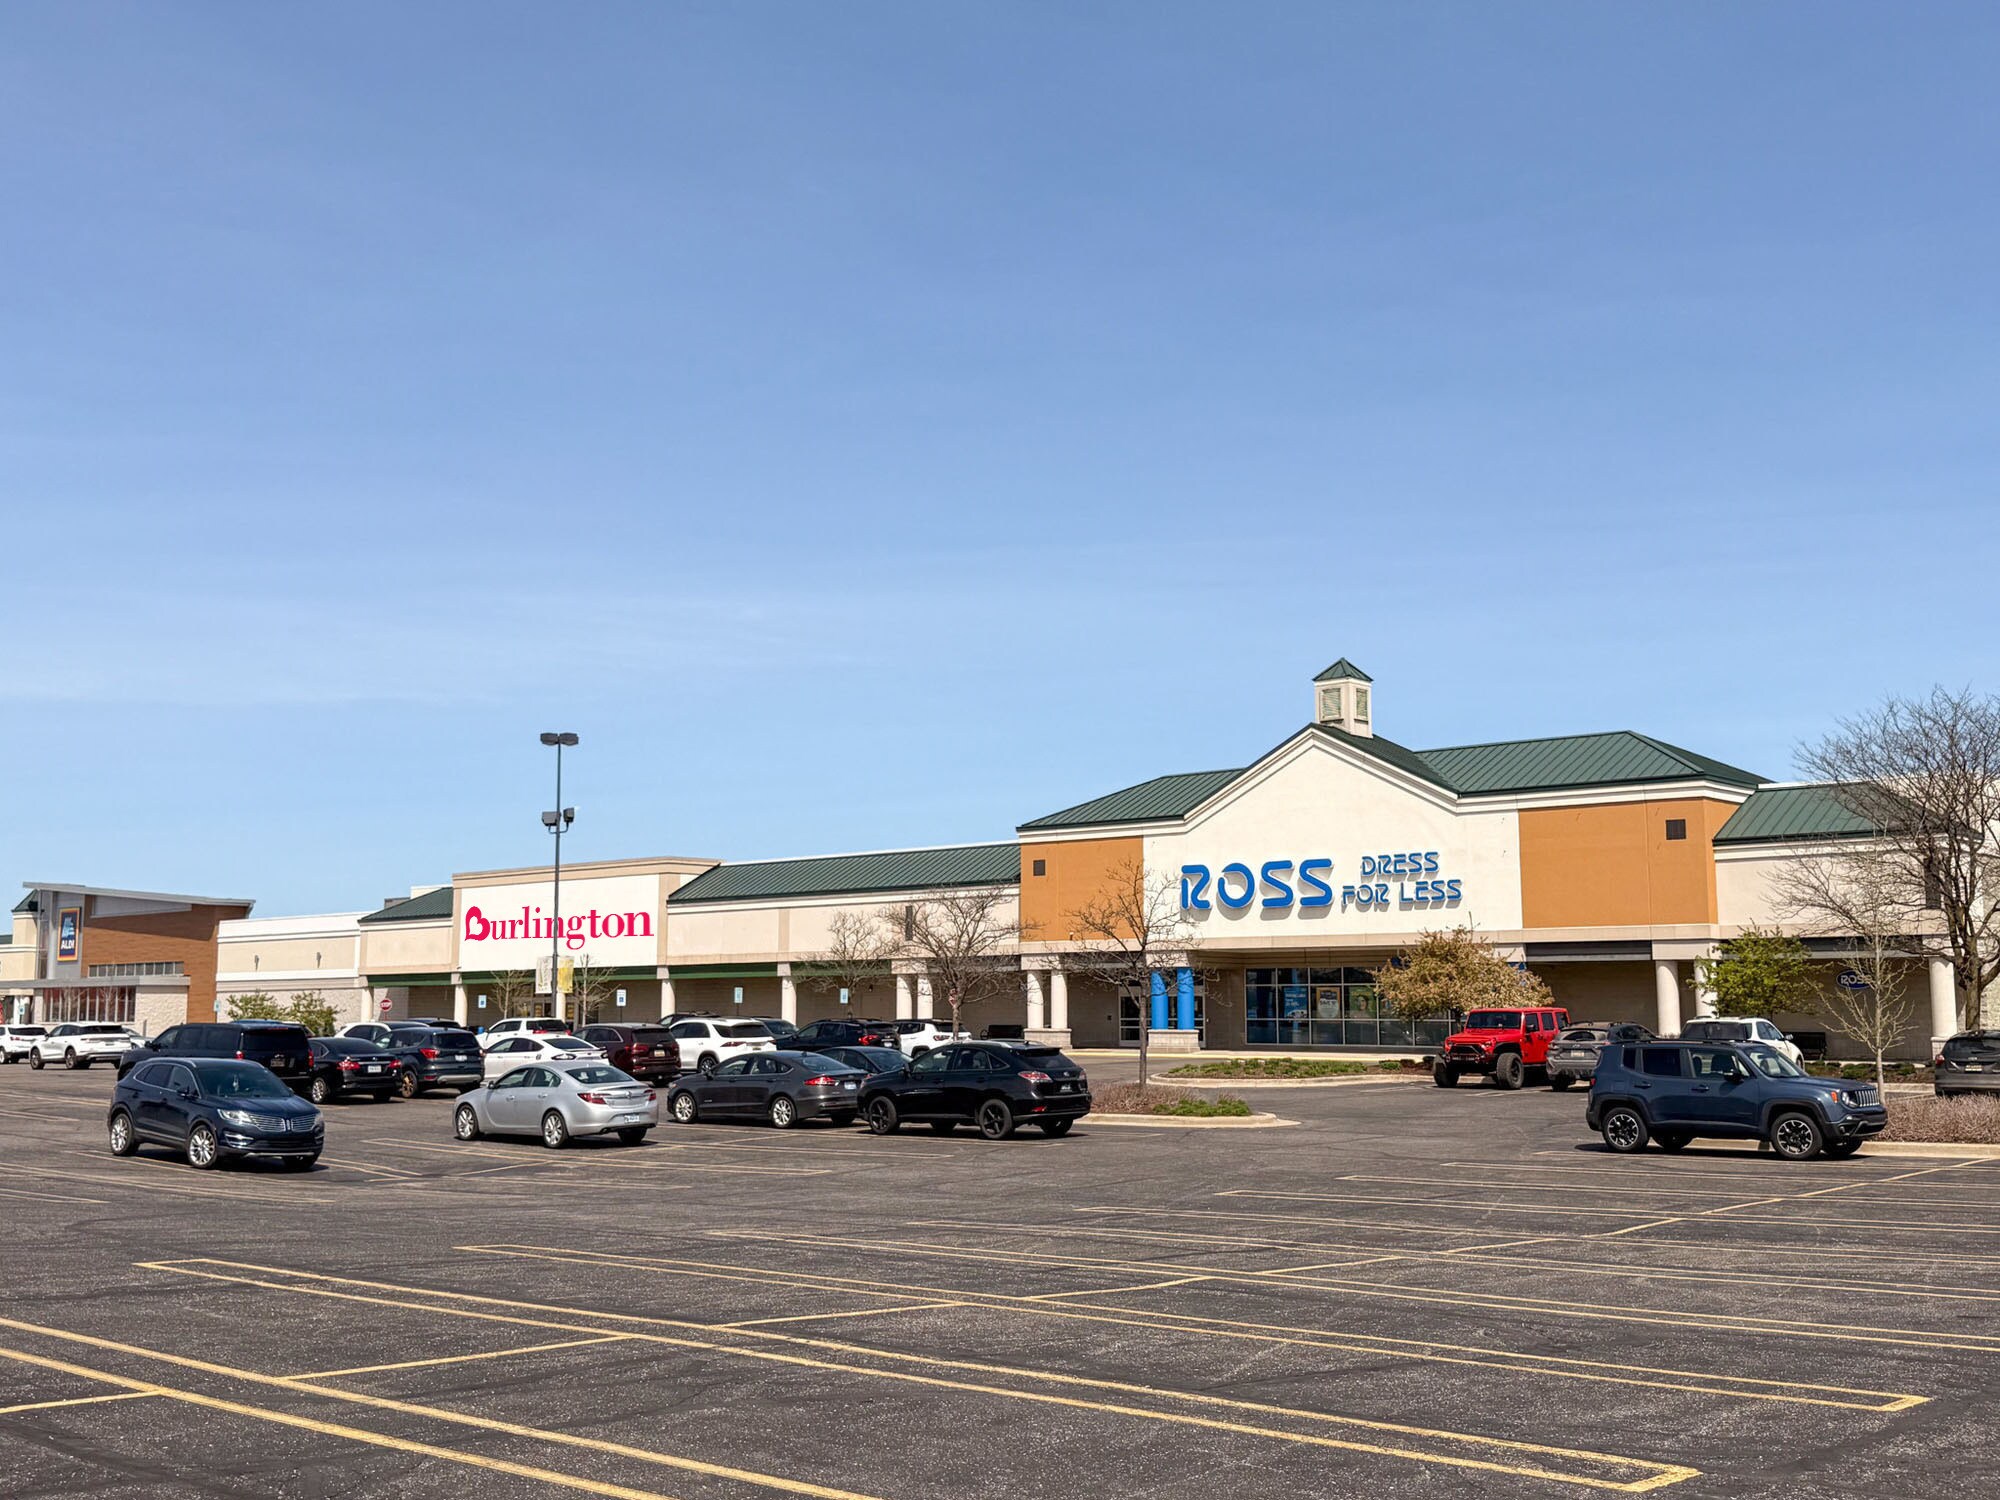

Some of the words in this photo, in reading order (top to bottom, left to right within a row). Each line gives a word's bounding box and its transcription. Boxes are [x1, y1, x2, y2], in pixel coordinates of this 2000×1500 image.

[1362, 851, 1439, 876] DRESS
[1181, 858, 1334, 911] ROSS
[1342, 885, 1389, 905] FOR
[1400, 879, 1462, 903] LESS
[464, 905, 655, 951] Burlington
[61, 939, 75, 950] ALDI
